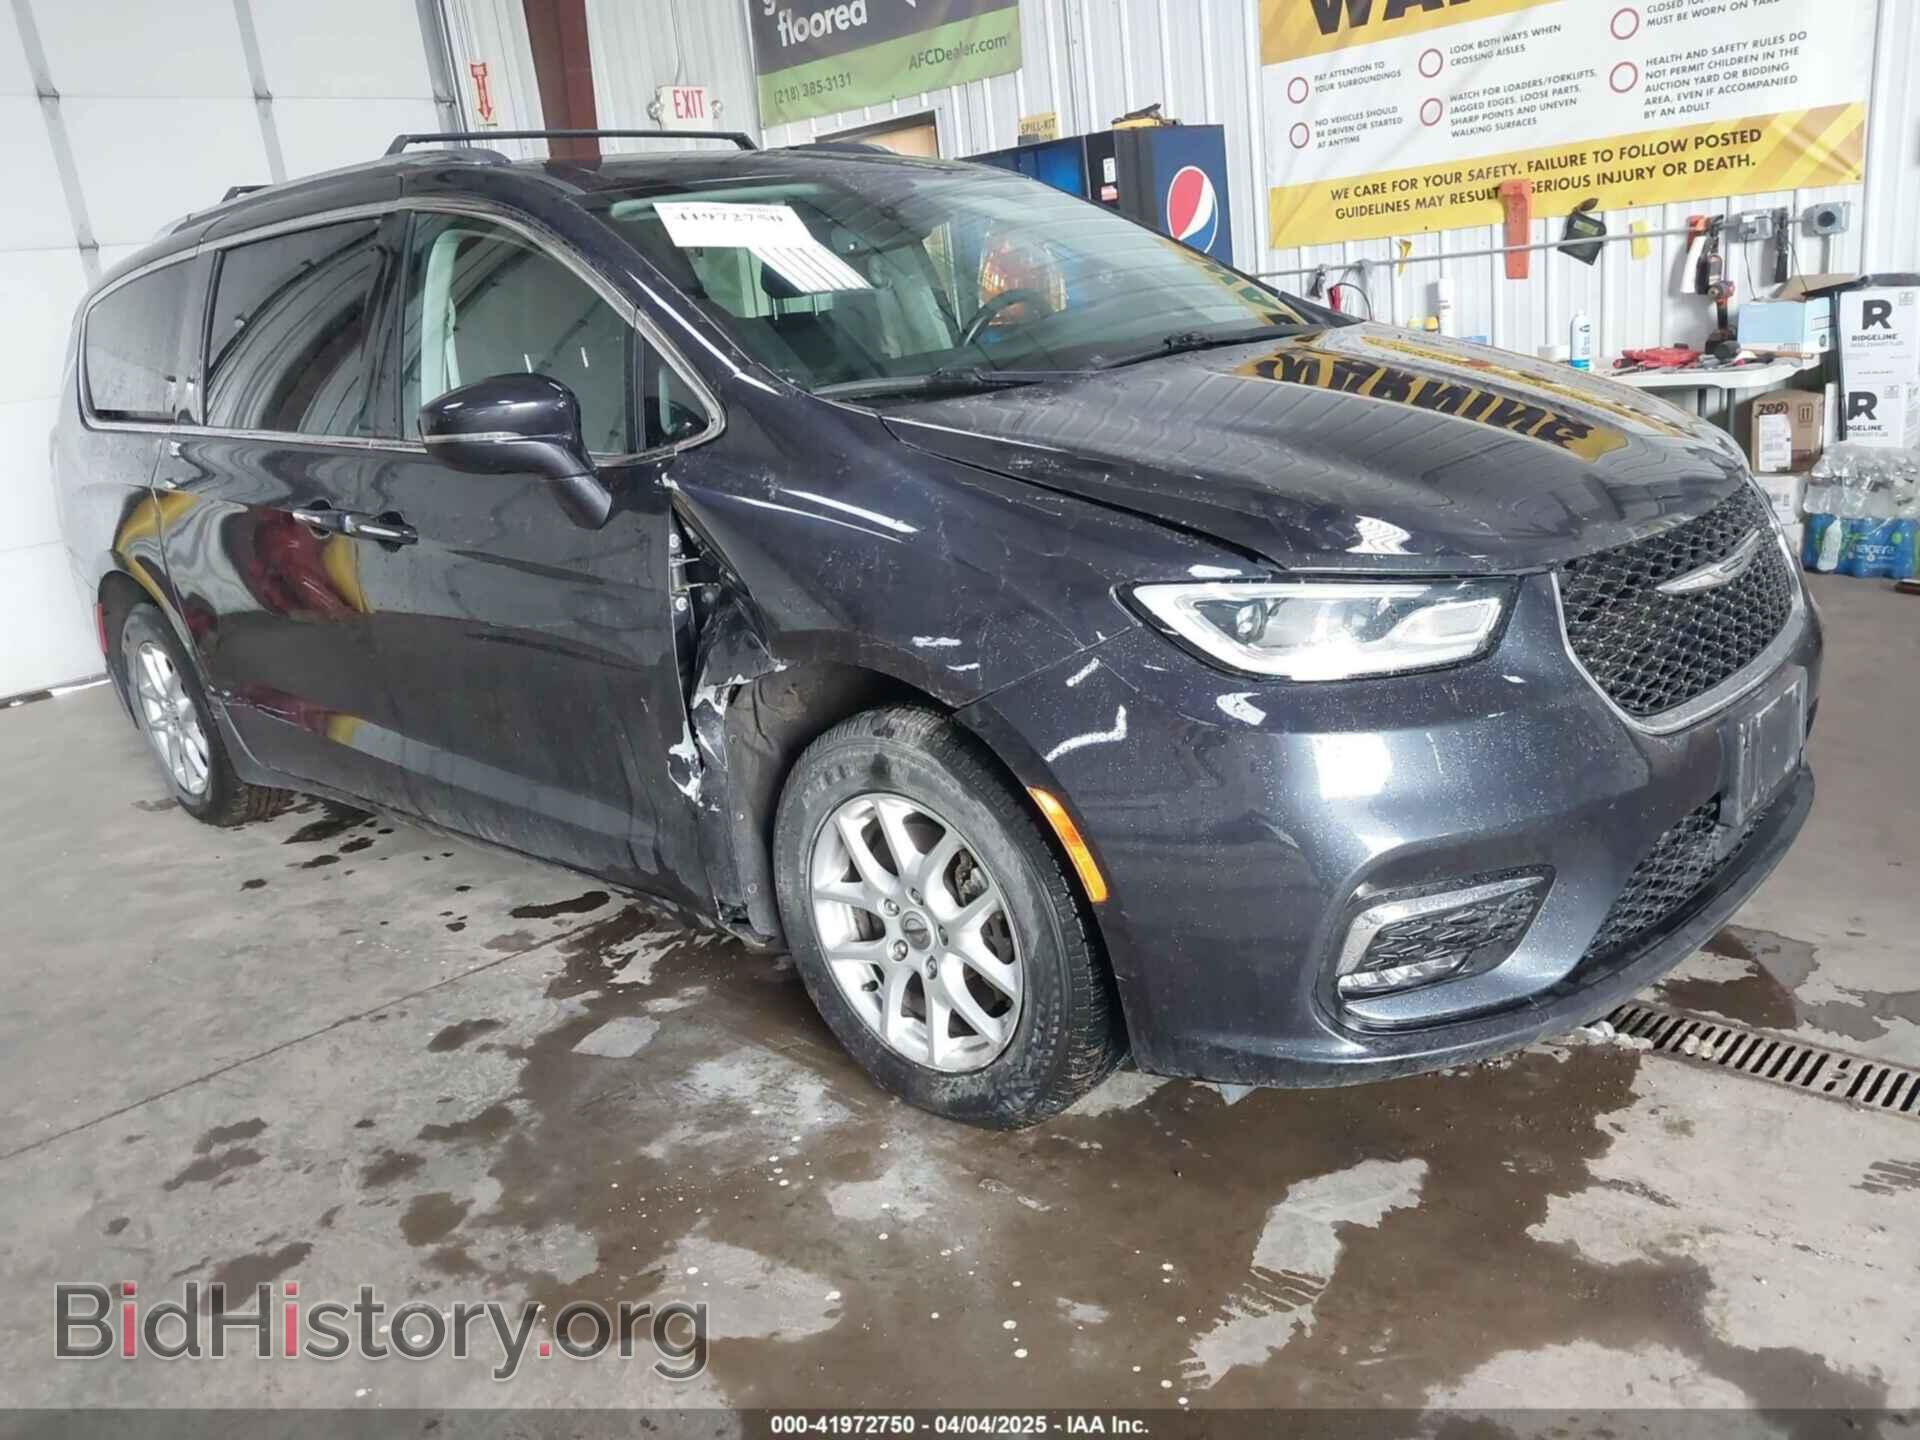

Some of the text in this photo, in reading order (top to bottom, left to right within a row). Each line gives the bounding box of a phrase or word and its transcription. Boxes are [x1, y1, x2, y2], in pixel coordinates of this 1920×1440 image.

[777, 0, 867, 47] floored
[1647, 14, 1673, 26] MUST
[1676, 11, 1688, 21] BE
[1691, 4, 1726, 18] WORN
[1730, 0, 1748, 11] ON
[908, 35, 1007, 71] AFCDealer.com
[1450, 24, 1561, 54] LOOK BOTH WAYS WHEN
[1646, 31, 1807, 67] HEALTH AND SAFETY RULES DO
[1450, 43, 1525, 66] CROSSING AISLES
[1645, 46, 1800, 80] NOT PERMIT CHILDREN IN THE
[1330, 63, 1372, 78] ATTENTION
[1374, 61, 1385, 69] TO
[1338, 70, 1401, 89] SURROUNDINGS
[1645, 62, 1790, 93] AUCTION YARD OR BIDDING
[773, 72, 852, 106] (218) 385-3131
[1450, 68, 1597, 103] WATCH FOR LOADERS/FORKLIFTS,
[1677, 87, 1703, 101] EVEN
[1706, 87, 1714, 96] IF
[1717, 75, 1798, 95] ACCOMPANIED
[672, 90, 704, 119] EXIT
[1450, 101, 1485, 114] JAGGED
[1520, 89, 1548, 102] LOOSE
[1450, 97, 1577, 126] SHARP POINTS AND UNEVEN
[1643, 101, 1710, 120] BY AN ADULT
[1315, 106, 1398, 127] NO VEHICLES SHOULD
[1328, 125, 1354, 136] DRIVEN
[1356, 122, 1367, 131] OR
[1370, 117, 1402, 128] STARTED
[1450, 117, 1537, 138] WALKING SURFACES
[1317, 135, 1360, 149] AT ANYTIME
[1330, 128, 1761, 201] WE CARE FOR YOUR SAFETY. FAILURE TO FOLLOW POSTED
[1597, 164, 1655, 186] INJURY
[1662, 161, 1687, 177] OR
[1693, 153, 1756, 174] DEATH.
[1335, 186, 1500, 220] GUIDELINES MAY RESULT
[1862, 300, 1892, 330] R
[1852, 333, 1897, 341] RIDGELINE
[1848, 391, 1878, 420] R
